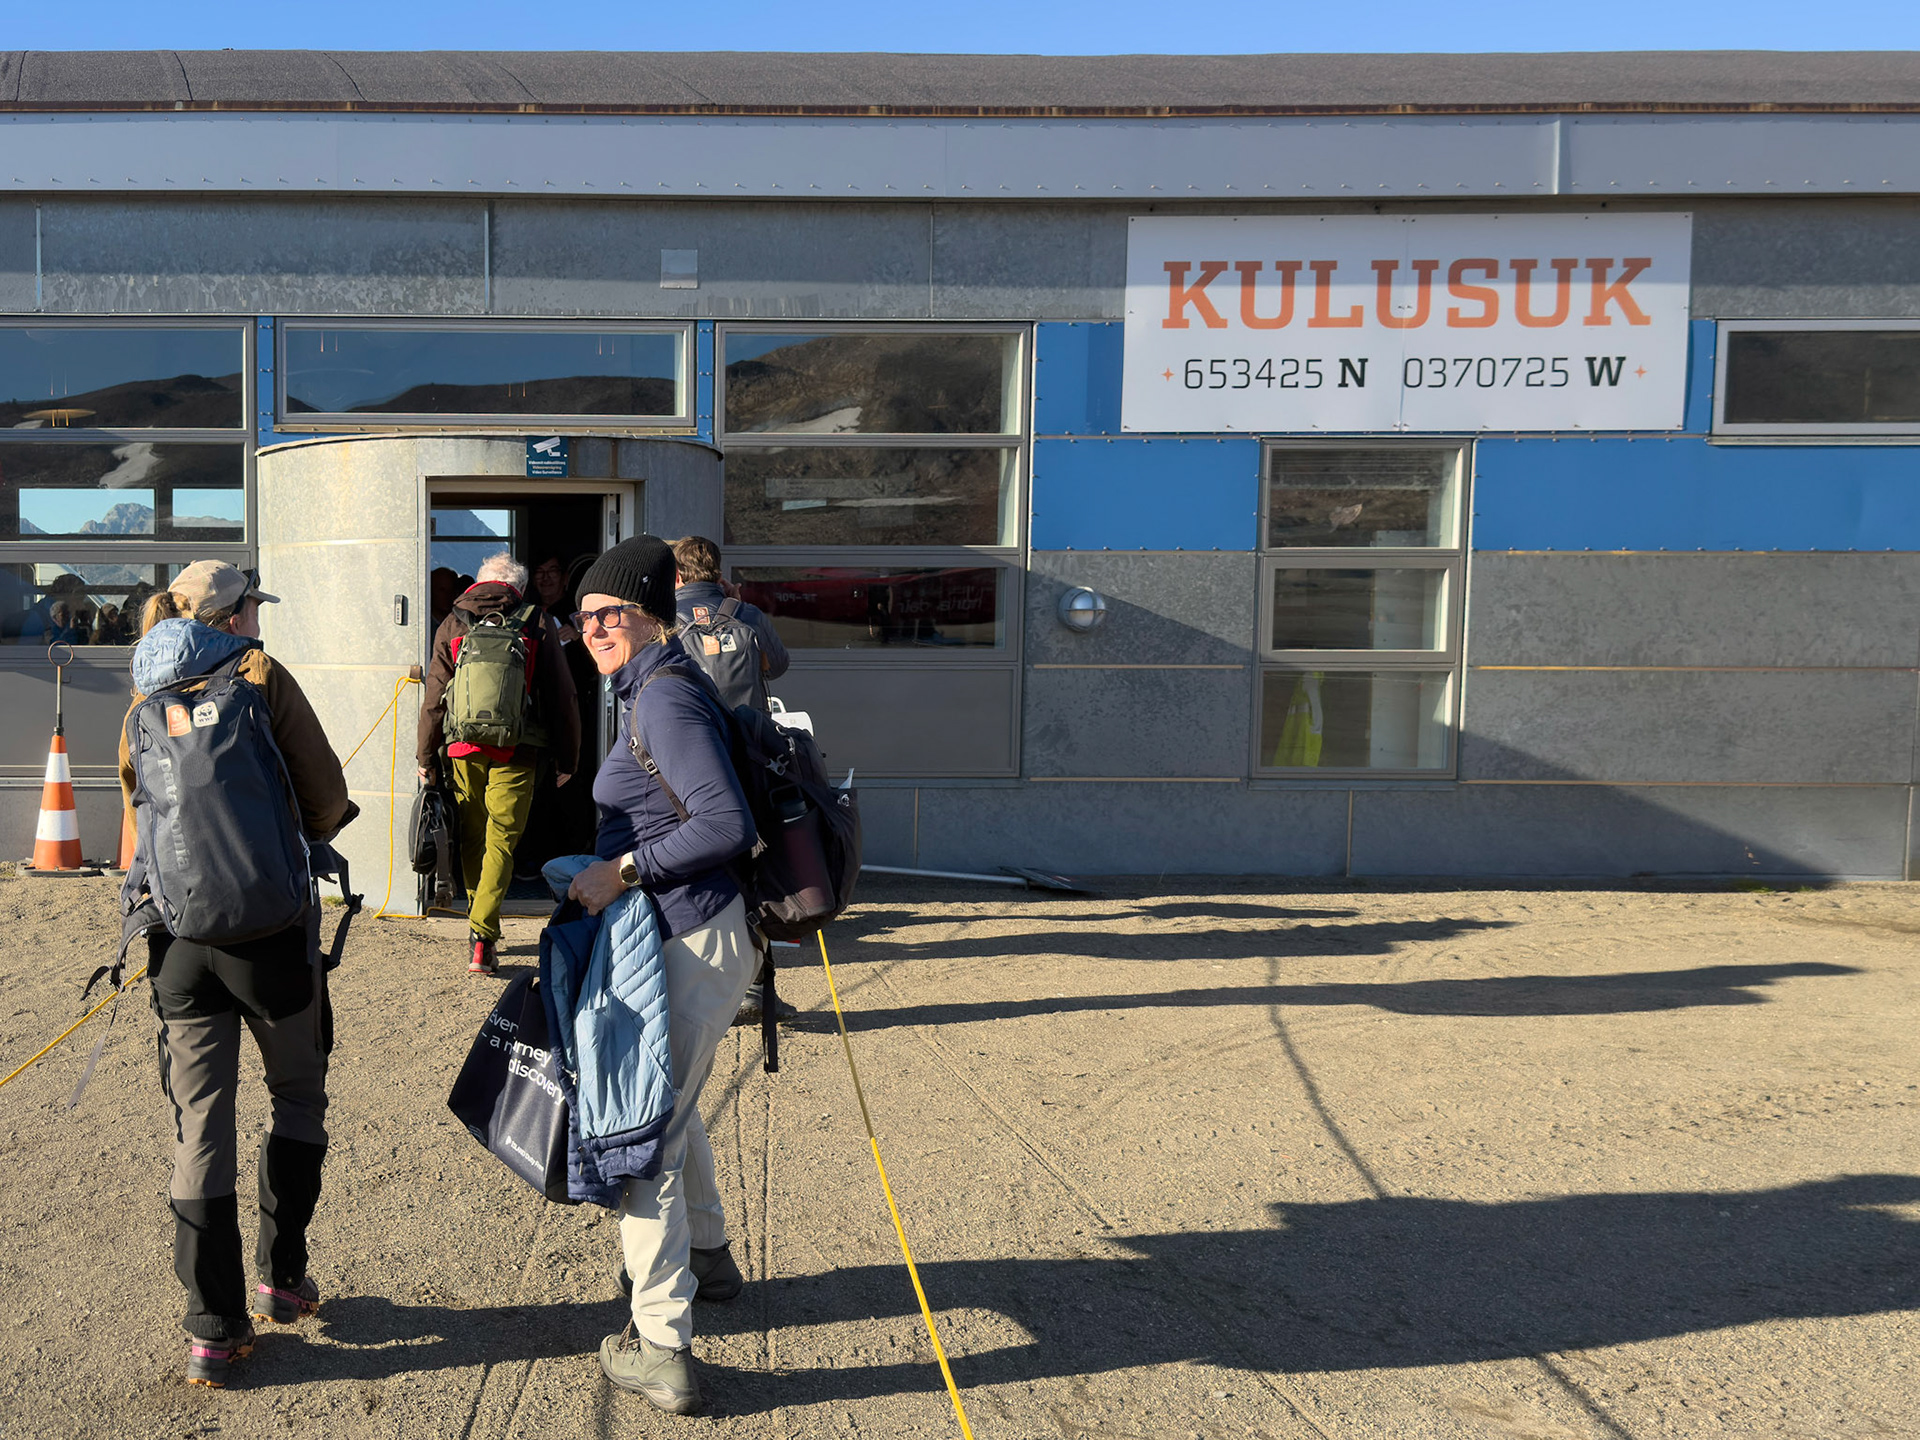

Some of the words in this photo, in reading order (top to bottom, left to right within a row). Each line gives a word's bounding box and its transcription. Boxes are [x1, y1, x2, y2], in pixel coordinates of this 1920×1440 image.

[1161, 257, 1652, 330] KULUSUK
[1183, 358, 1324, 389] 653425
[1337, 357, 1369, 388] N
[1403, 357, 1570, 388] 0370725
[1584, 355, 1627, 387] W
[157, 757, 190, 871] pataonia
[488, 1008, 519, 1034] Ever
[489, 1035, 501, 1048] a
[508, 1058, 565, 1106] discovery
